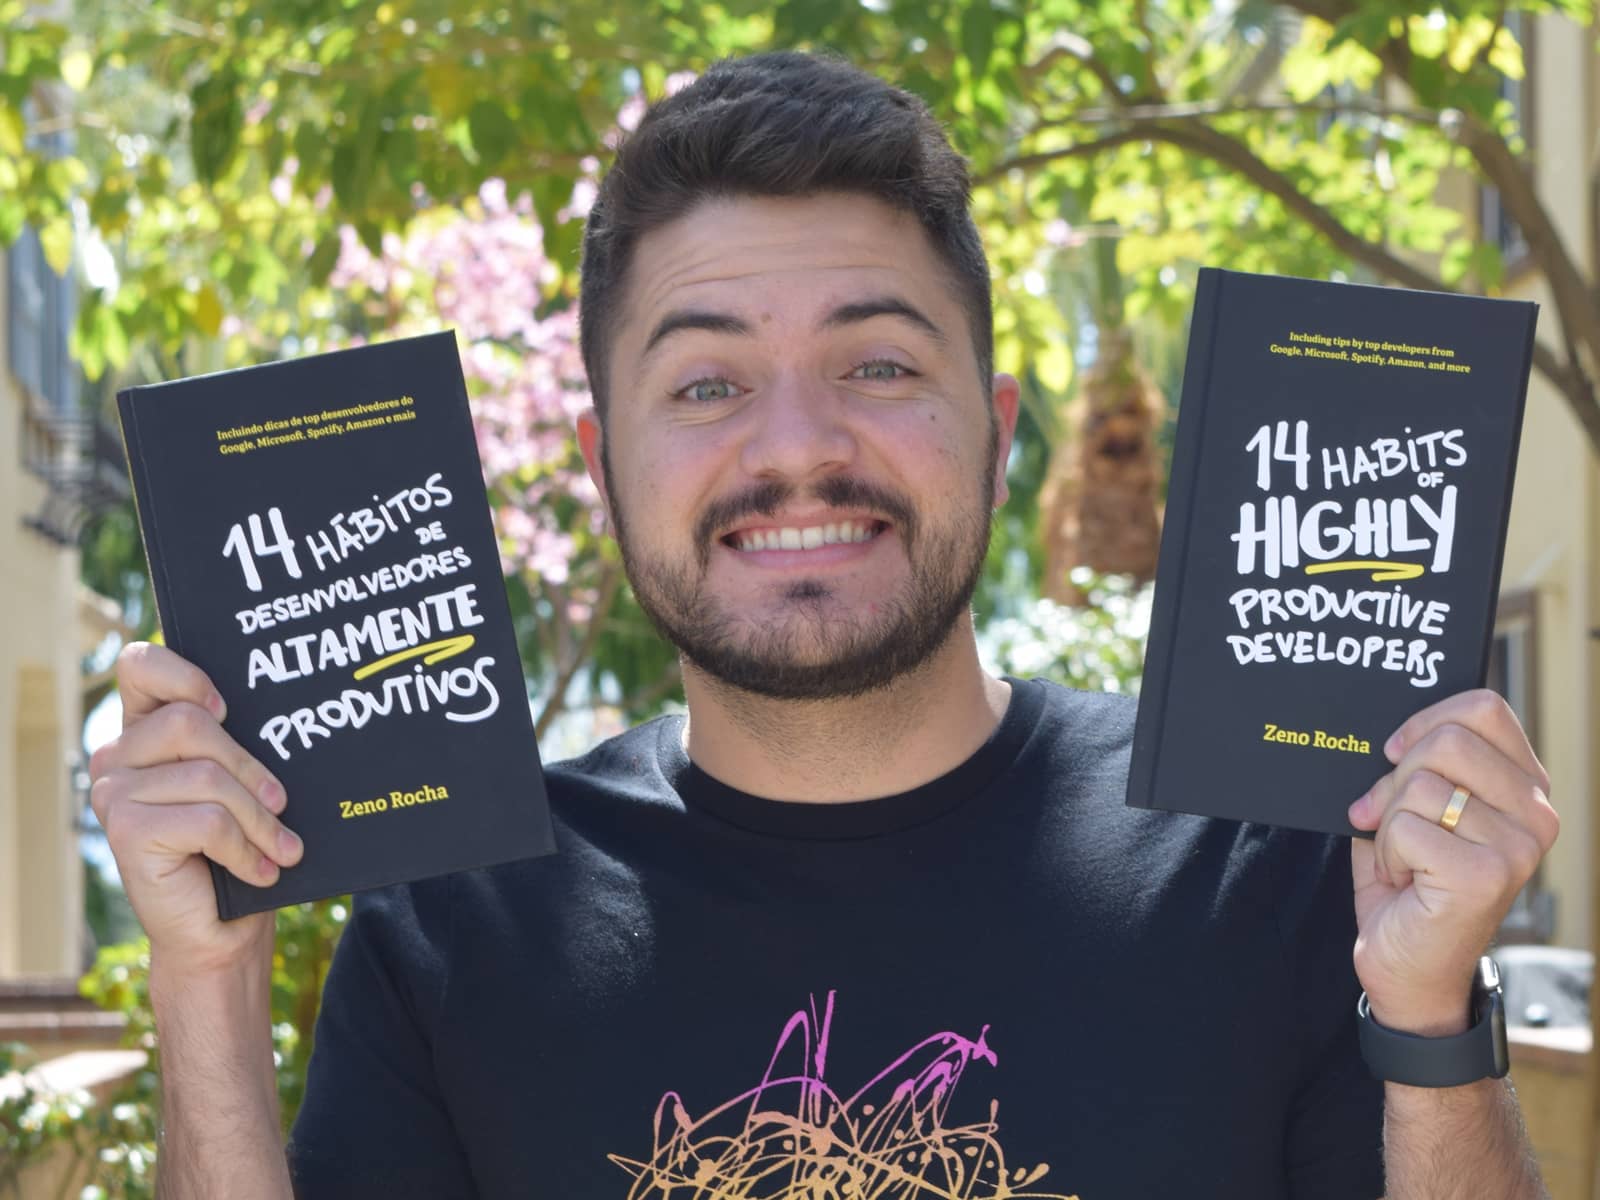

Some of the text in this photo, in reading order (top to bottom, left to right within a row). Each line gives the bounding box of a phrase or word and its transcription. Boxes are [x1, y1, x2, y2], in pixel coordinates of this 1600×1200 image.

[1270, 344, 1303, 357] Google,
[1387, 356, 1427, 369] Amazon,
[1428, 360, 1446, 371] and
[1447, 364, 1471, 374] more
[1289, 332, 1455, 357] Including tips by top developers from
[216, 395, 414, 441] Incluindo dicas de top desenvolvedores do
[219, 437, 257, 455] Google,
[346, 415, 385, 432] Amazon
[386, 414, 392, 424] e
[393, 409, 416, 423] mais
[1245, 419, 1312, 492] 14
[1417, 470, 1445, 489] OF
[222, 506, 303, 592] 14
[414, 520, 447, 545] DE
[1230, 484, 1458, 579] HIGHLY
[235, 546, 472, 635] DESENVOLVEDORES
[247, 583, 485, 689] ALTAMENTE
[1225, 630, 1445, 688] DEVELOPERS
[1263, 723, 1371, 755] Zeno Rocha
[339, 784, 449, 819] Zeno Rocha
